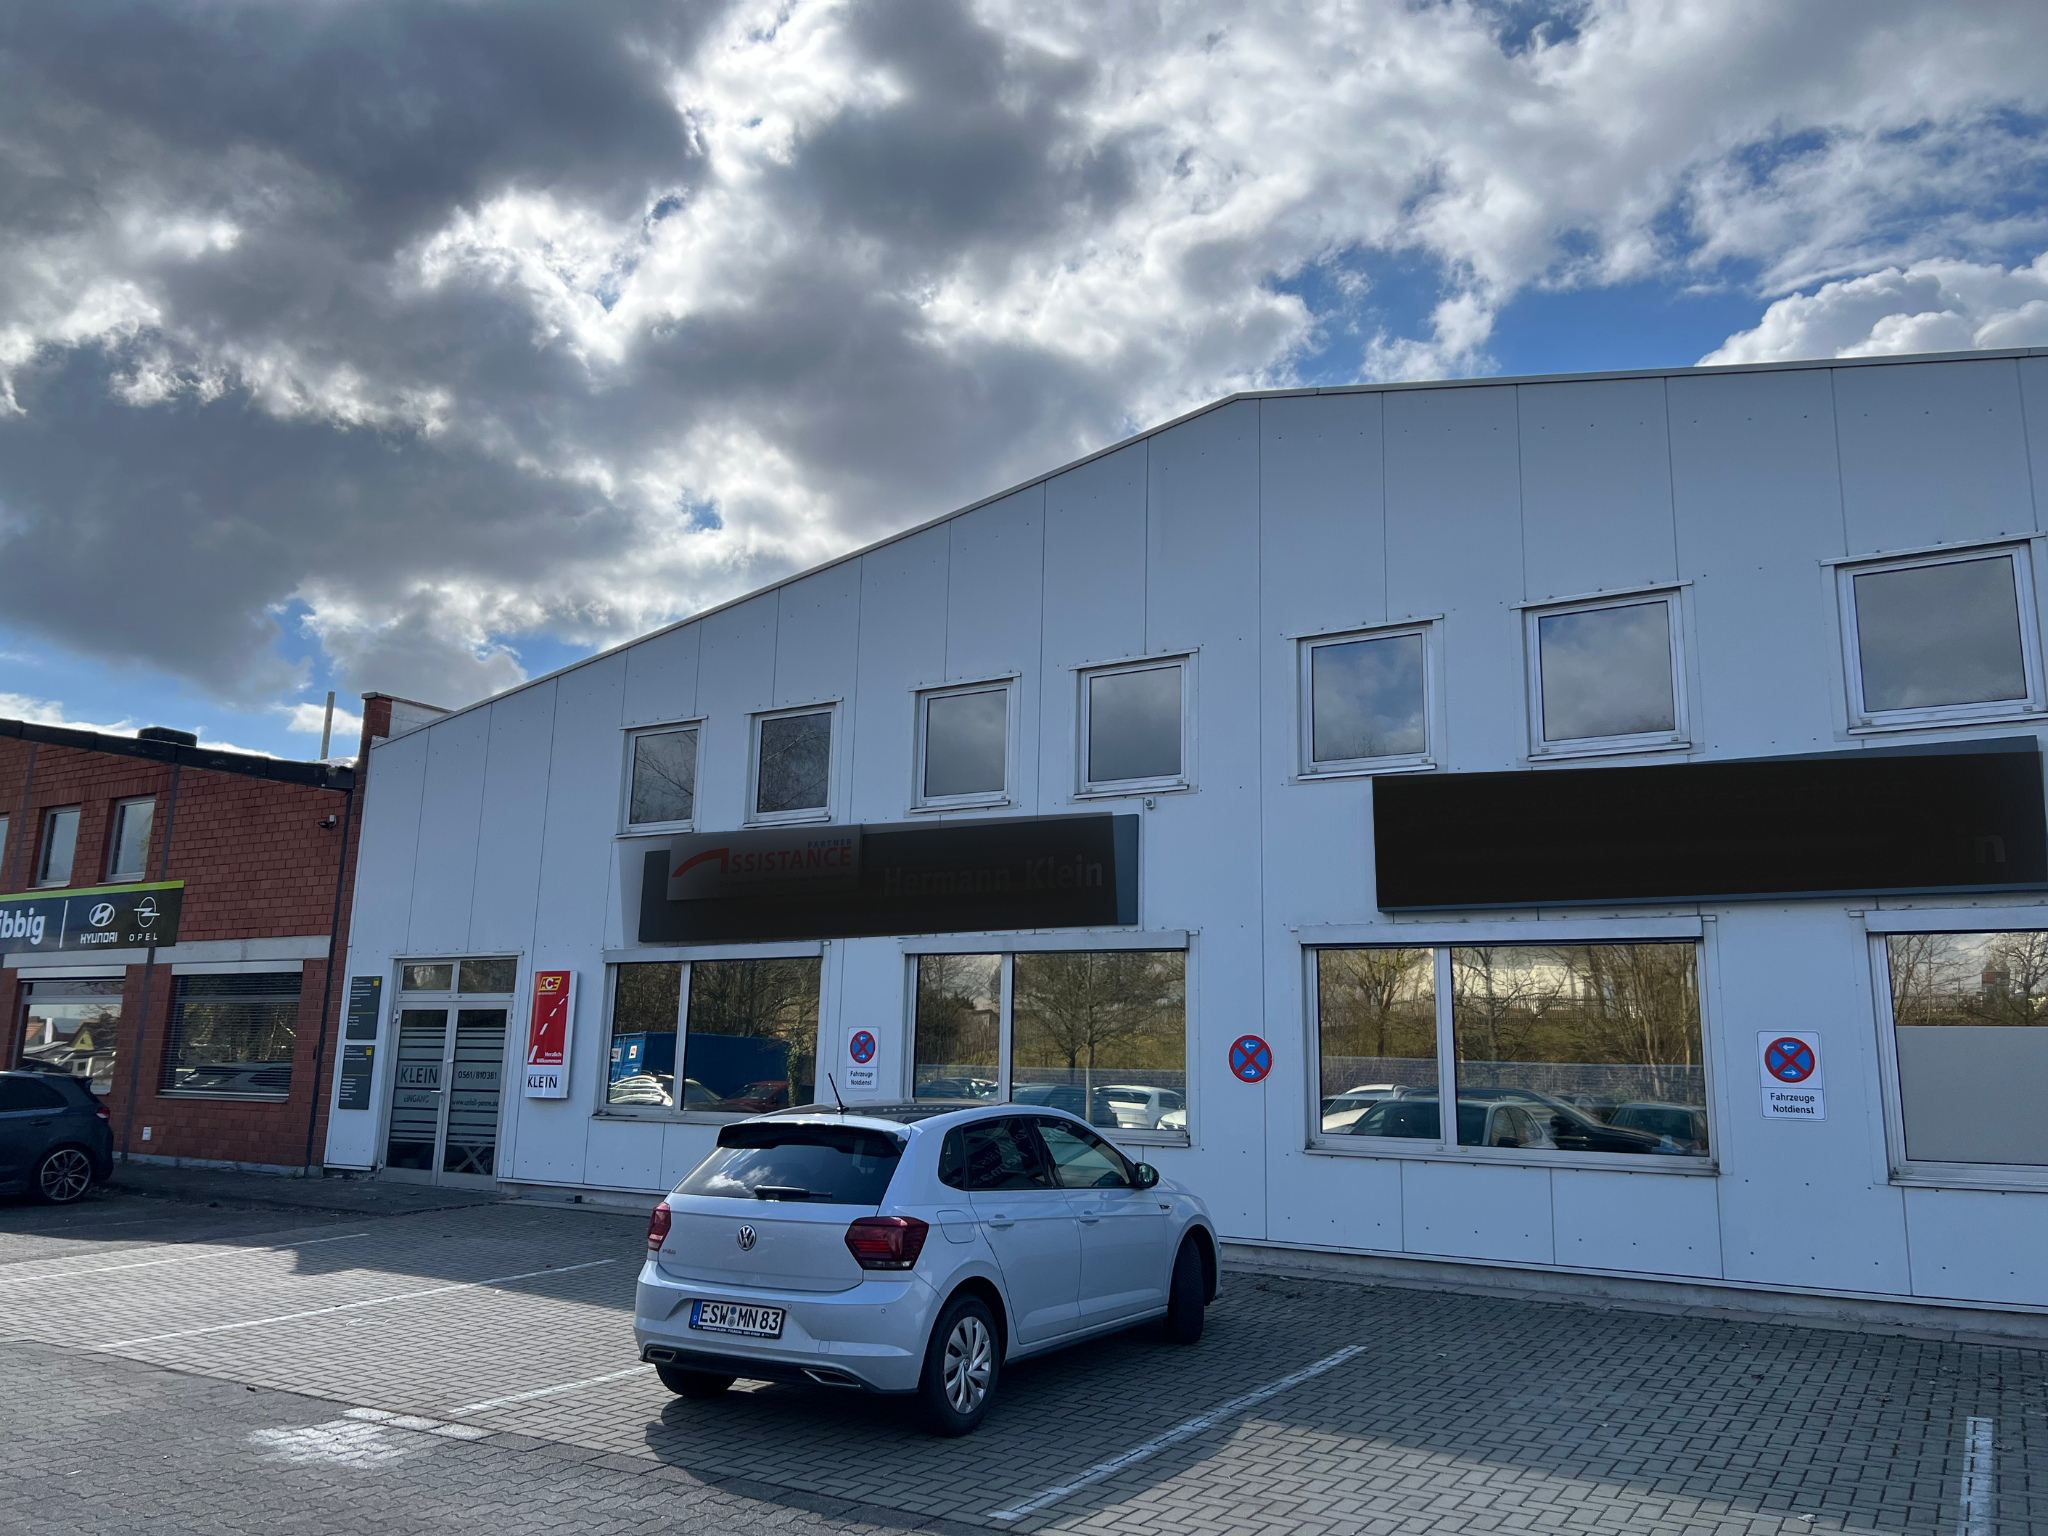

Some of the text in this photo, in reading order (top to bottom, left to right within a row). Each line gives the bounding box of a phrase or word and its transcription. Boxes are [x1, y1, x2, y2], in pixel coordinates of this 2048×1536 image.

[807, 838, 852, 849] PARTNER
[884, 854, 1103, 897] Hermann Klein
[80, 932, 158, 944] HYUNDAI OPEL
[539, 976, 562, 991] ACE
[400, 1067, 438, 1084] KLEIN
[850, 1070, 873, 1078] Fahrzeuge
[527, 1076, 557, 1088] KLEIN
[1770, 1092, 1815, 1103] Fahrzeuge
[1773, 1104, 1815, 1114] Notdienst
[700, 1304, 730, 1325] ESW
[737, 1308, 758, 1329] MN
[760, 1311, 780, 1331] 83
